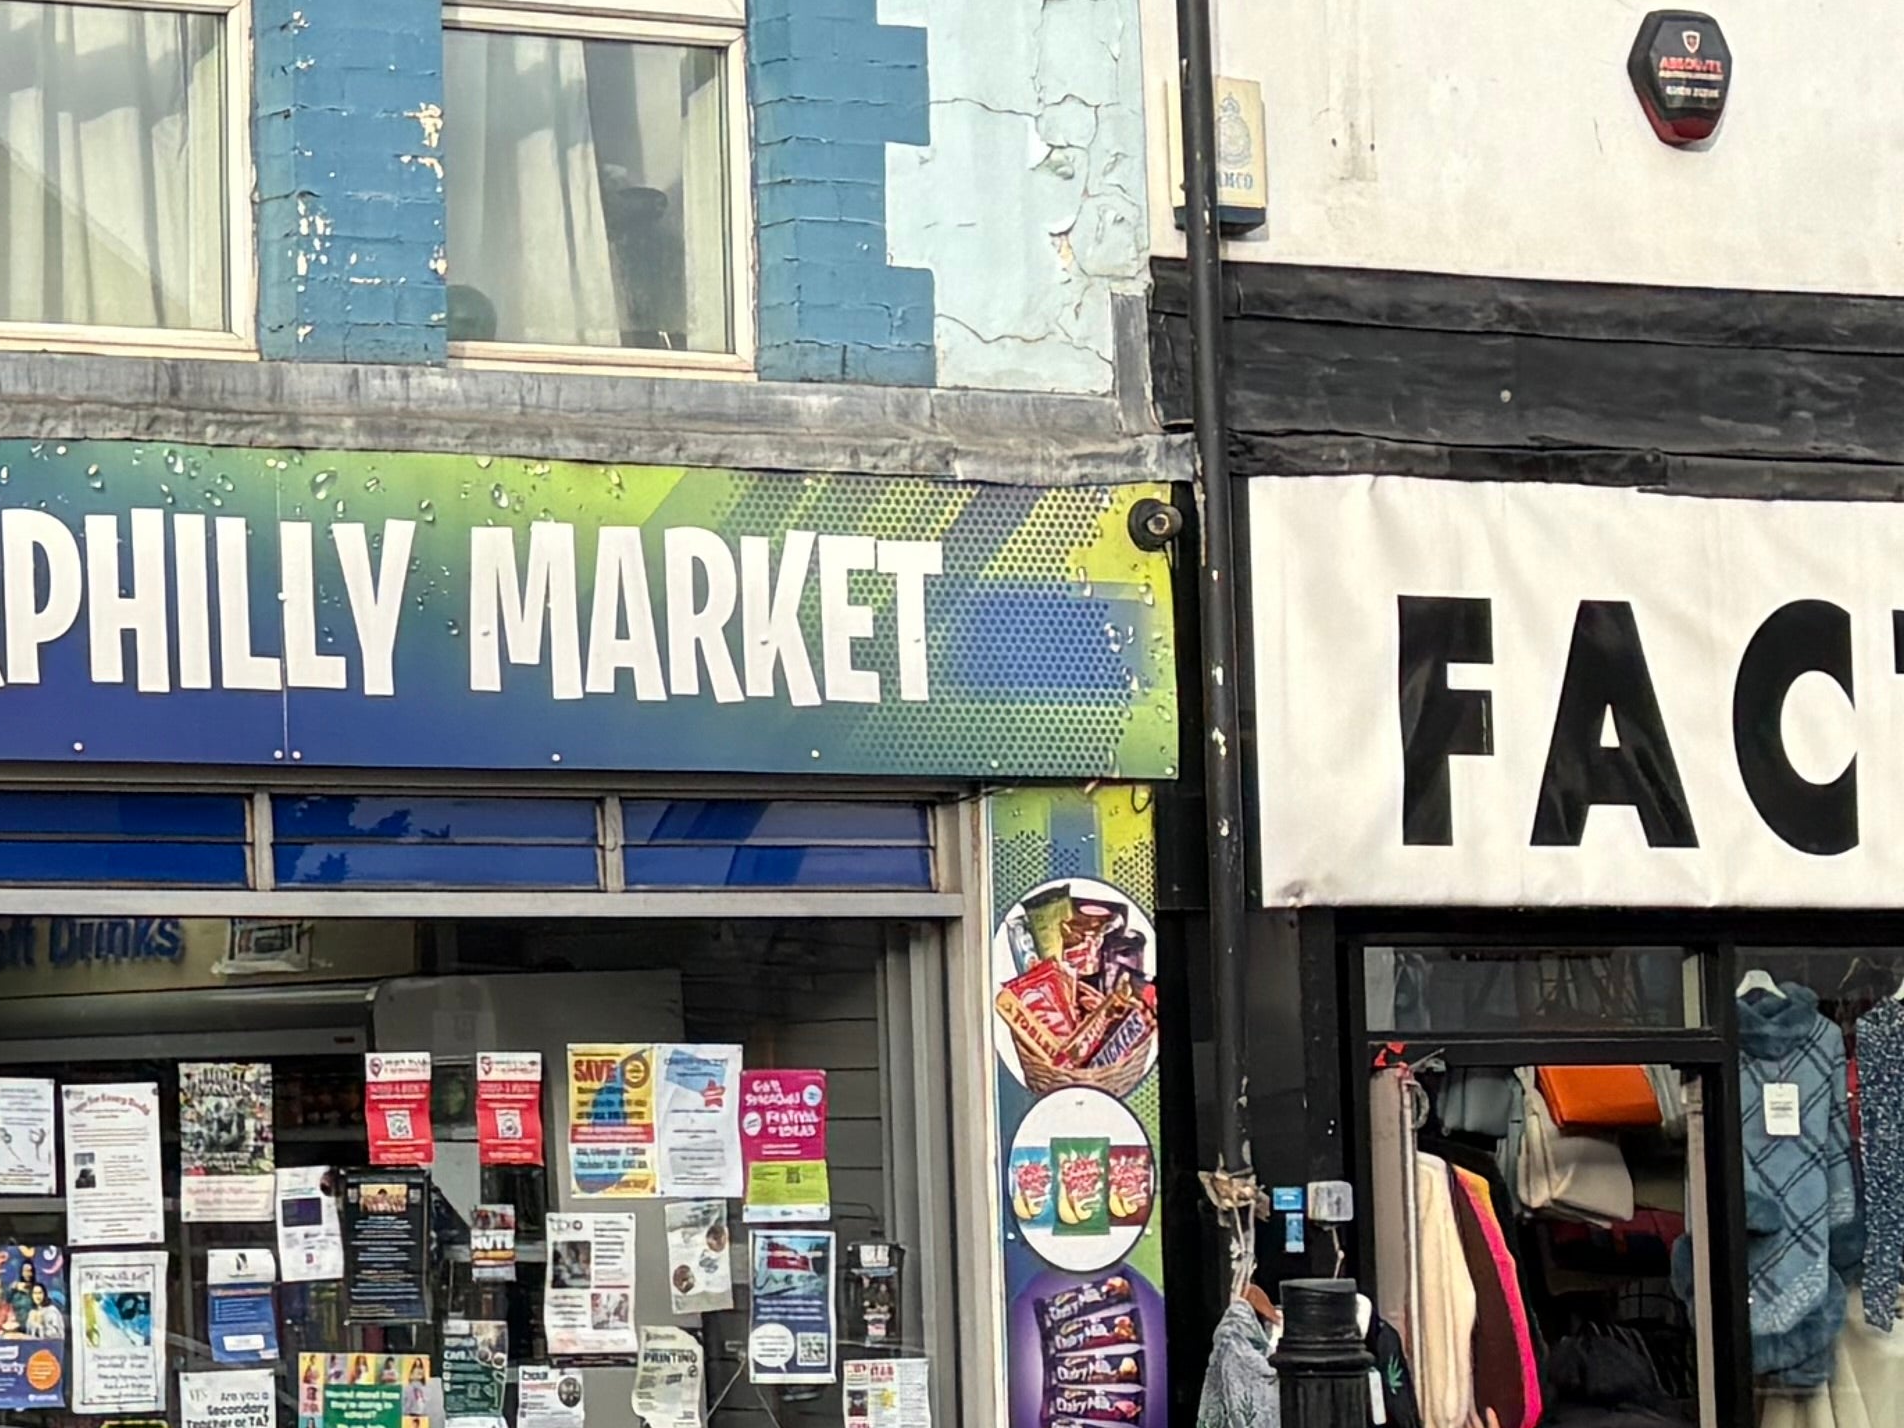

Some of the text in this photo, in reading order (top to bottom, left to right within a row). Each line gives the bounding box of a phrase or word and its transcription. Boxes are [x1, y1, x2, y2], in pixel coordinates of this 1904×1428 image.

[469, 521, 944, 707] MARKET
[1397, 594, 1904, 857] FAC
[574, 1059, 618, 1083] SAVE
[206, 1403, 270, 1418] Secondary
